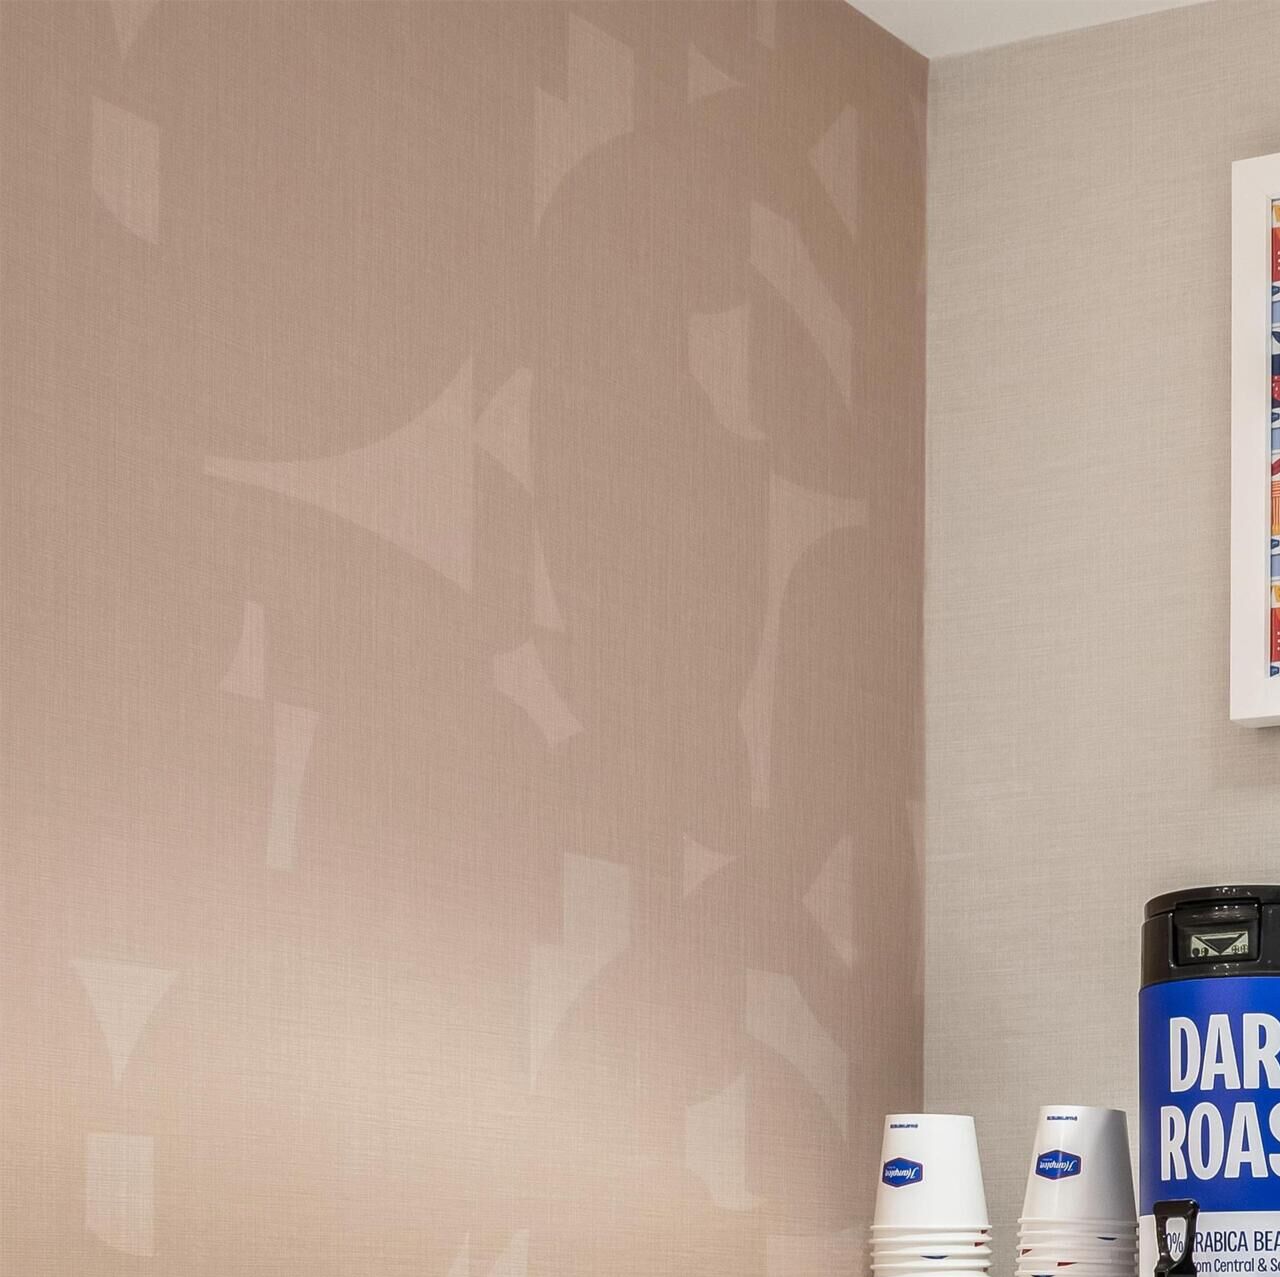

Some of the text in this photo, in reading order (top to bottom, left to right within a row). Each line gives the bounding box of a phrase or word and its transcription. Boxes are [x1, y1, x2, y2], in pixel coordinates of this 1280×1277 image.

[1193, 1231, 1249, 1252] RABICA
[1195, 1260, 1212, 1273] om
[1214, 1258, 1255, 1273] Central
[1258, 1258, 1267, 1272] &
